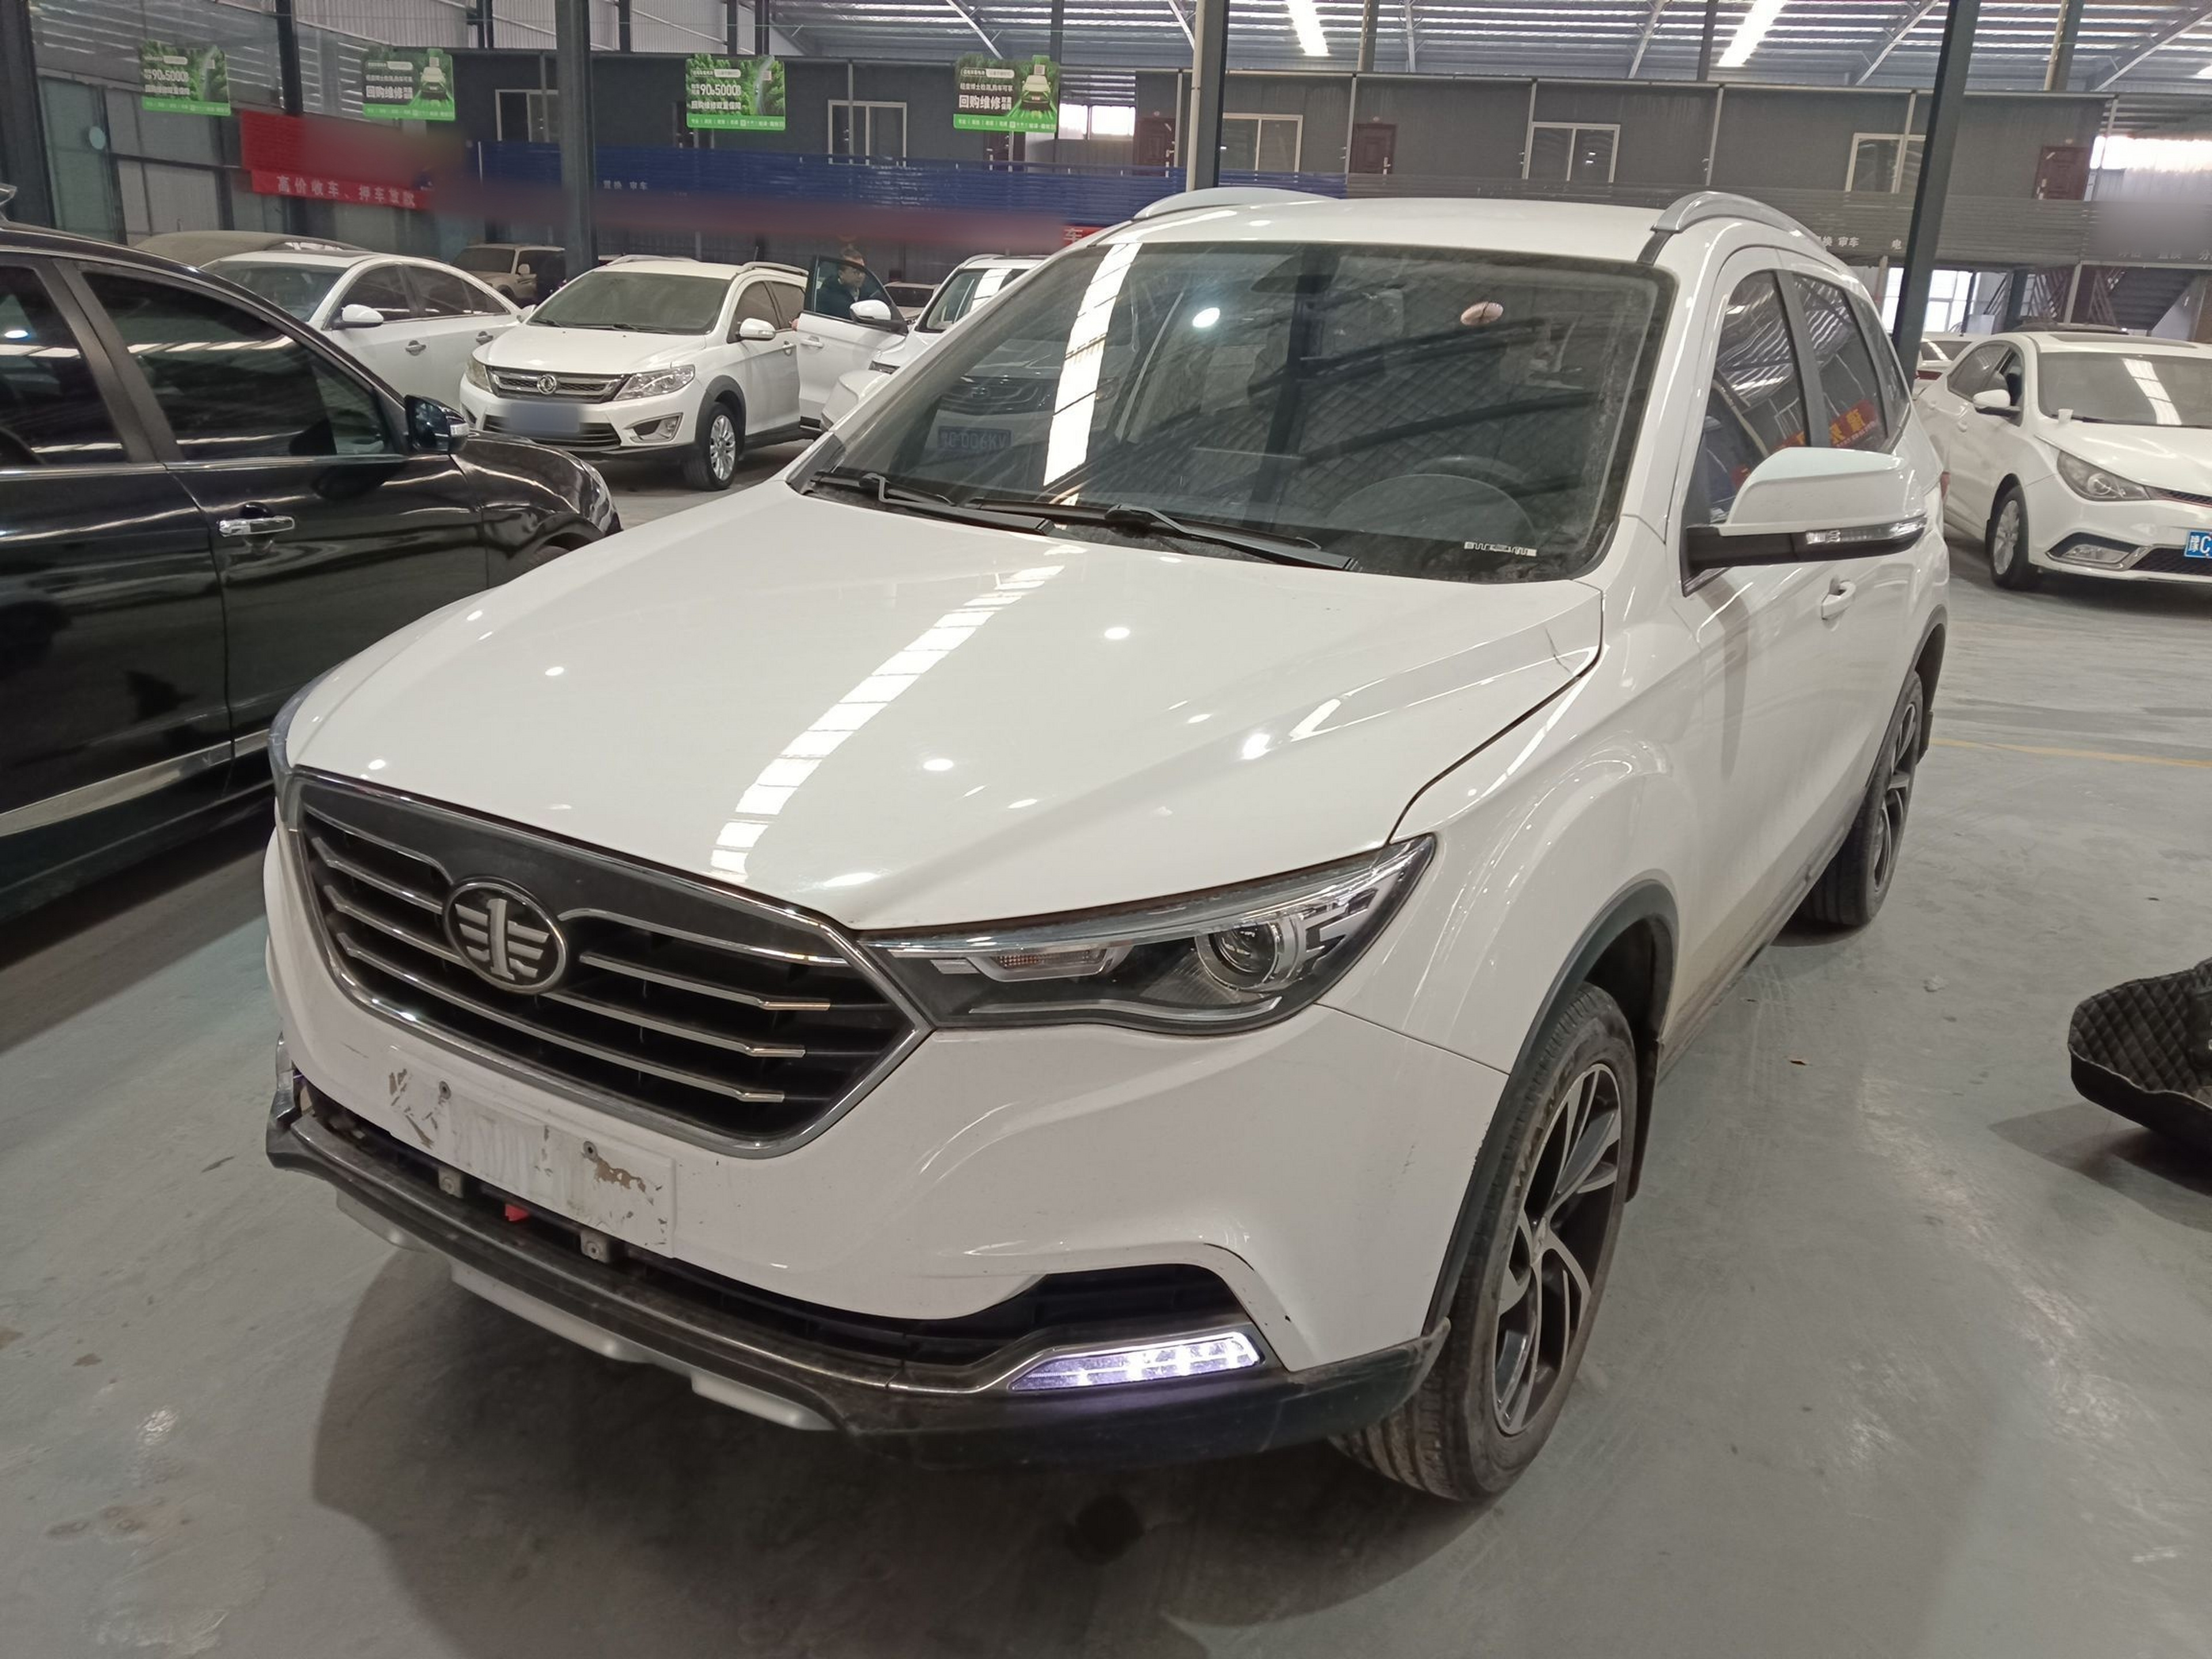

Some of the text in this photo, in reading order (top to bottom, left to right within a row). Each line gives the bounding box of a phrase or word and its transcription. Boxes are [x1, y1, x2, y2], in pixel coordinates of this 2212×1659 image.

[959, 94, 1001, 110] 回购维修
[1063, 228, 1084, 243] 车
[1838, 236, 1860, 248] 审车
[1891, 238, 1903, 250] 电
[2188, 535, 2211, 554] 豫C
